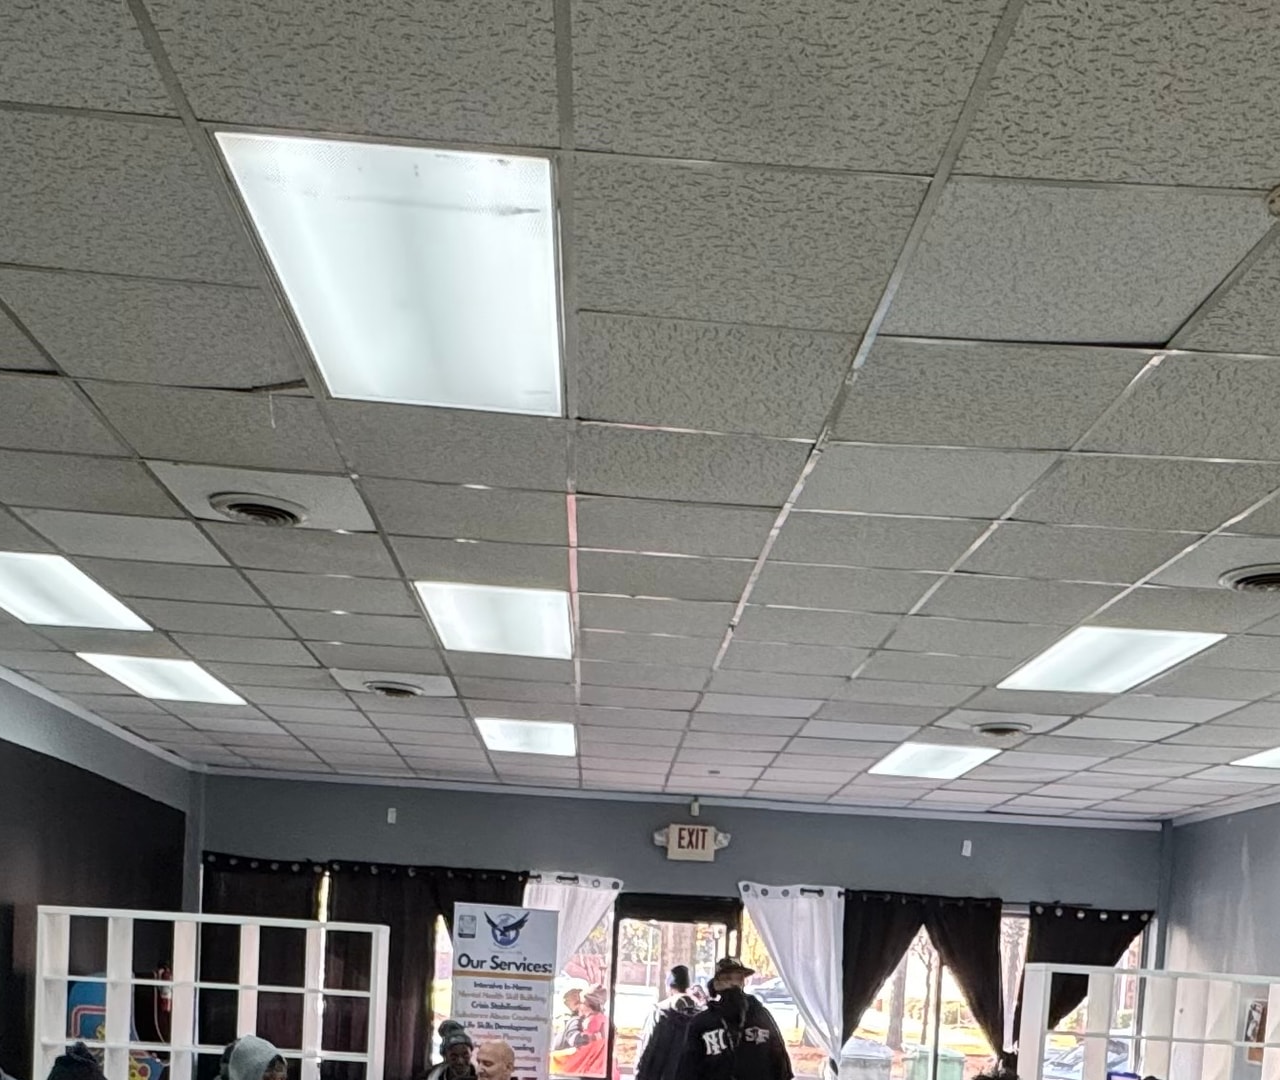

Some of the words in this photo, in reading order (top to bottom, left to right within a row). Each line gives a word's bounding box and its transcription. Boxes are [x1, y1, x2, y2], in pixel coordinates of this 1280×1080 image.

[677, 827, 709, 851] EXIT
[458, 953, 487, 969] Our
[490, 955, 552, 973] Services:
